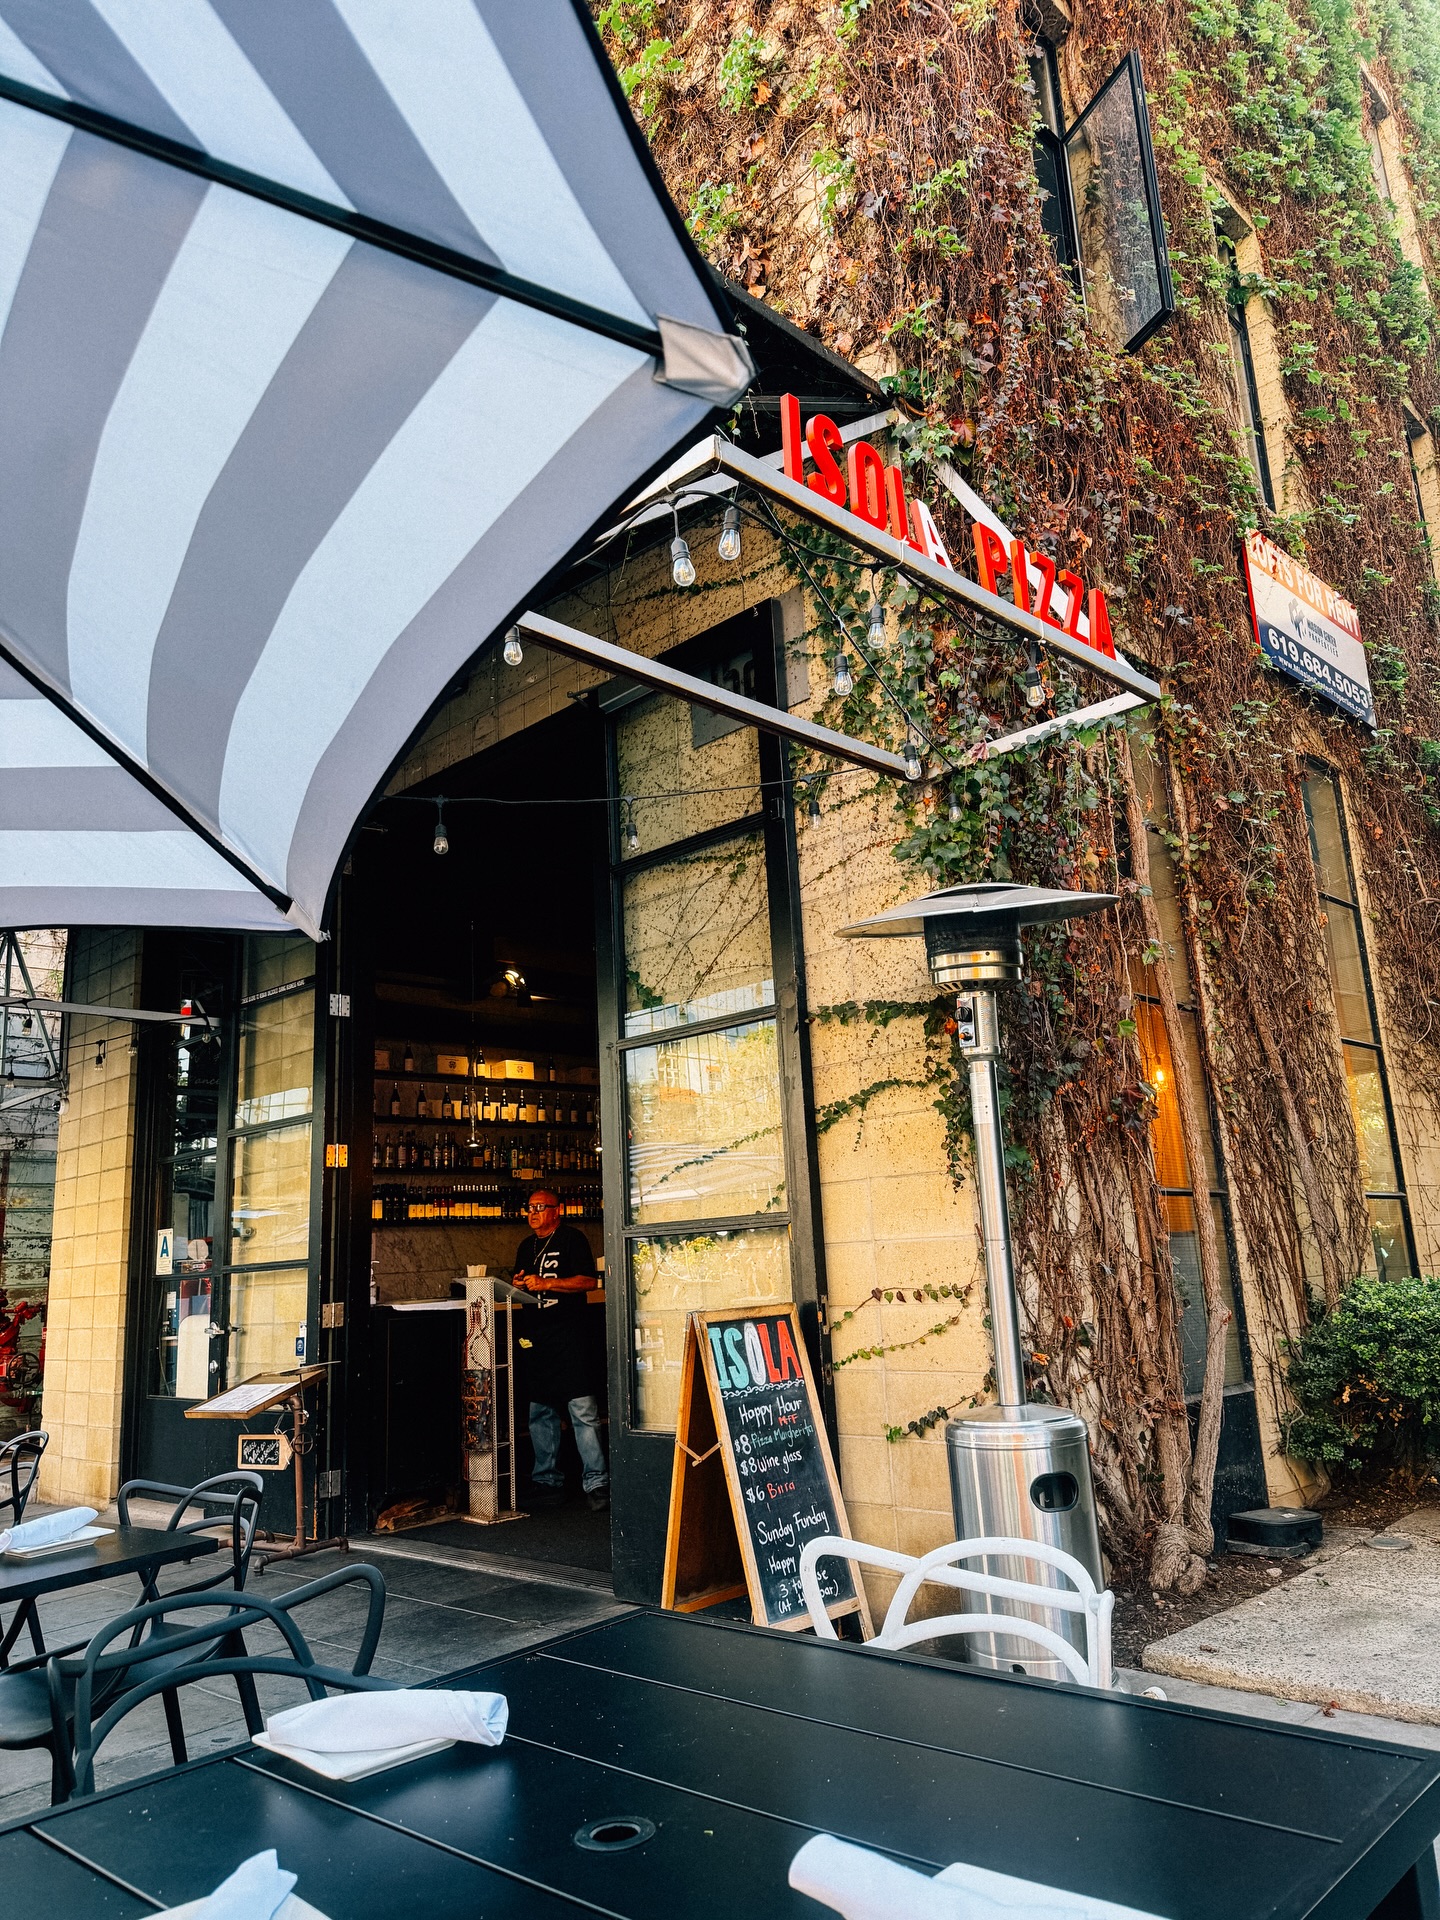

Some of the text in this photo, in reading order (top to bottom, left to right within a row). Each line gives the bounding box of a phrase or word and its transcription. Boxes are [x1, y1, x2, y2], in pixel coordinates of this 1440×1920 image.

[780, 393, 1117, 661] ISOLA PIZZA
[1249, 538, 1359, 637] LOFTS FOR RENT
[1268, 628, 1369, 709] 619.684.5053
[512, 1168, 545, 1180] COAIL
[160, 1236, 169, 1257] A
[543, 1252, 560, 1309] ISOA
[708, 1320, 803, 1389] ISOLA
[738, 1395, 803, 1428] Happy Hour
[734, 1434, 752, 1455] $8
[751, 1431, 773, 1449] Pizza
[782, 1450, 803, 1474] glass
[745, 1481, 796, 1504] $6 Birra
[757, 1505, 830, 1548] Sunday Funday
[767, 1555, 797, 1576] Happy
[780, 1583, 789, 1598] 3
